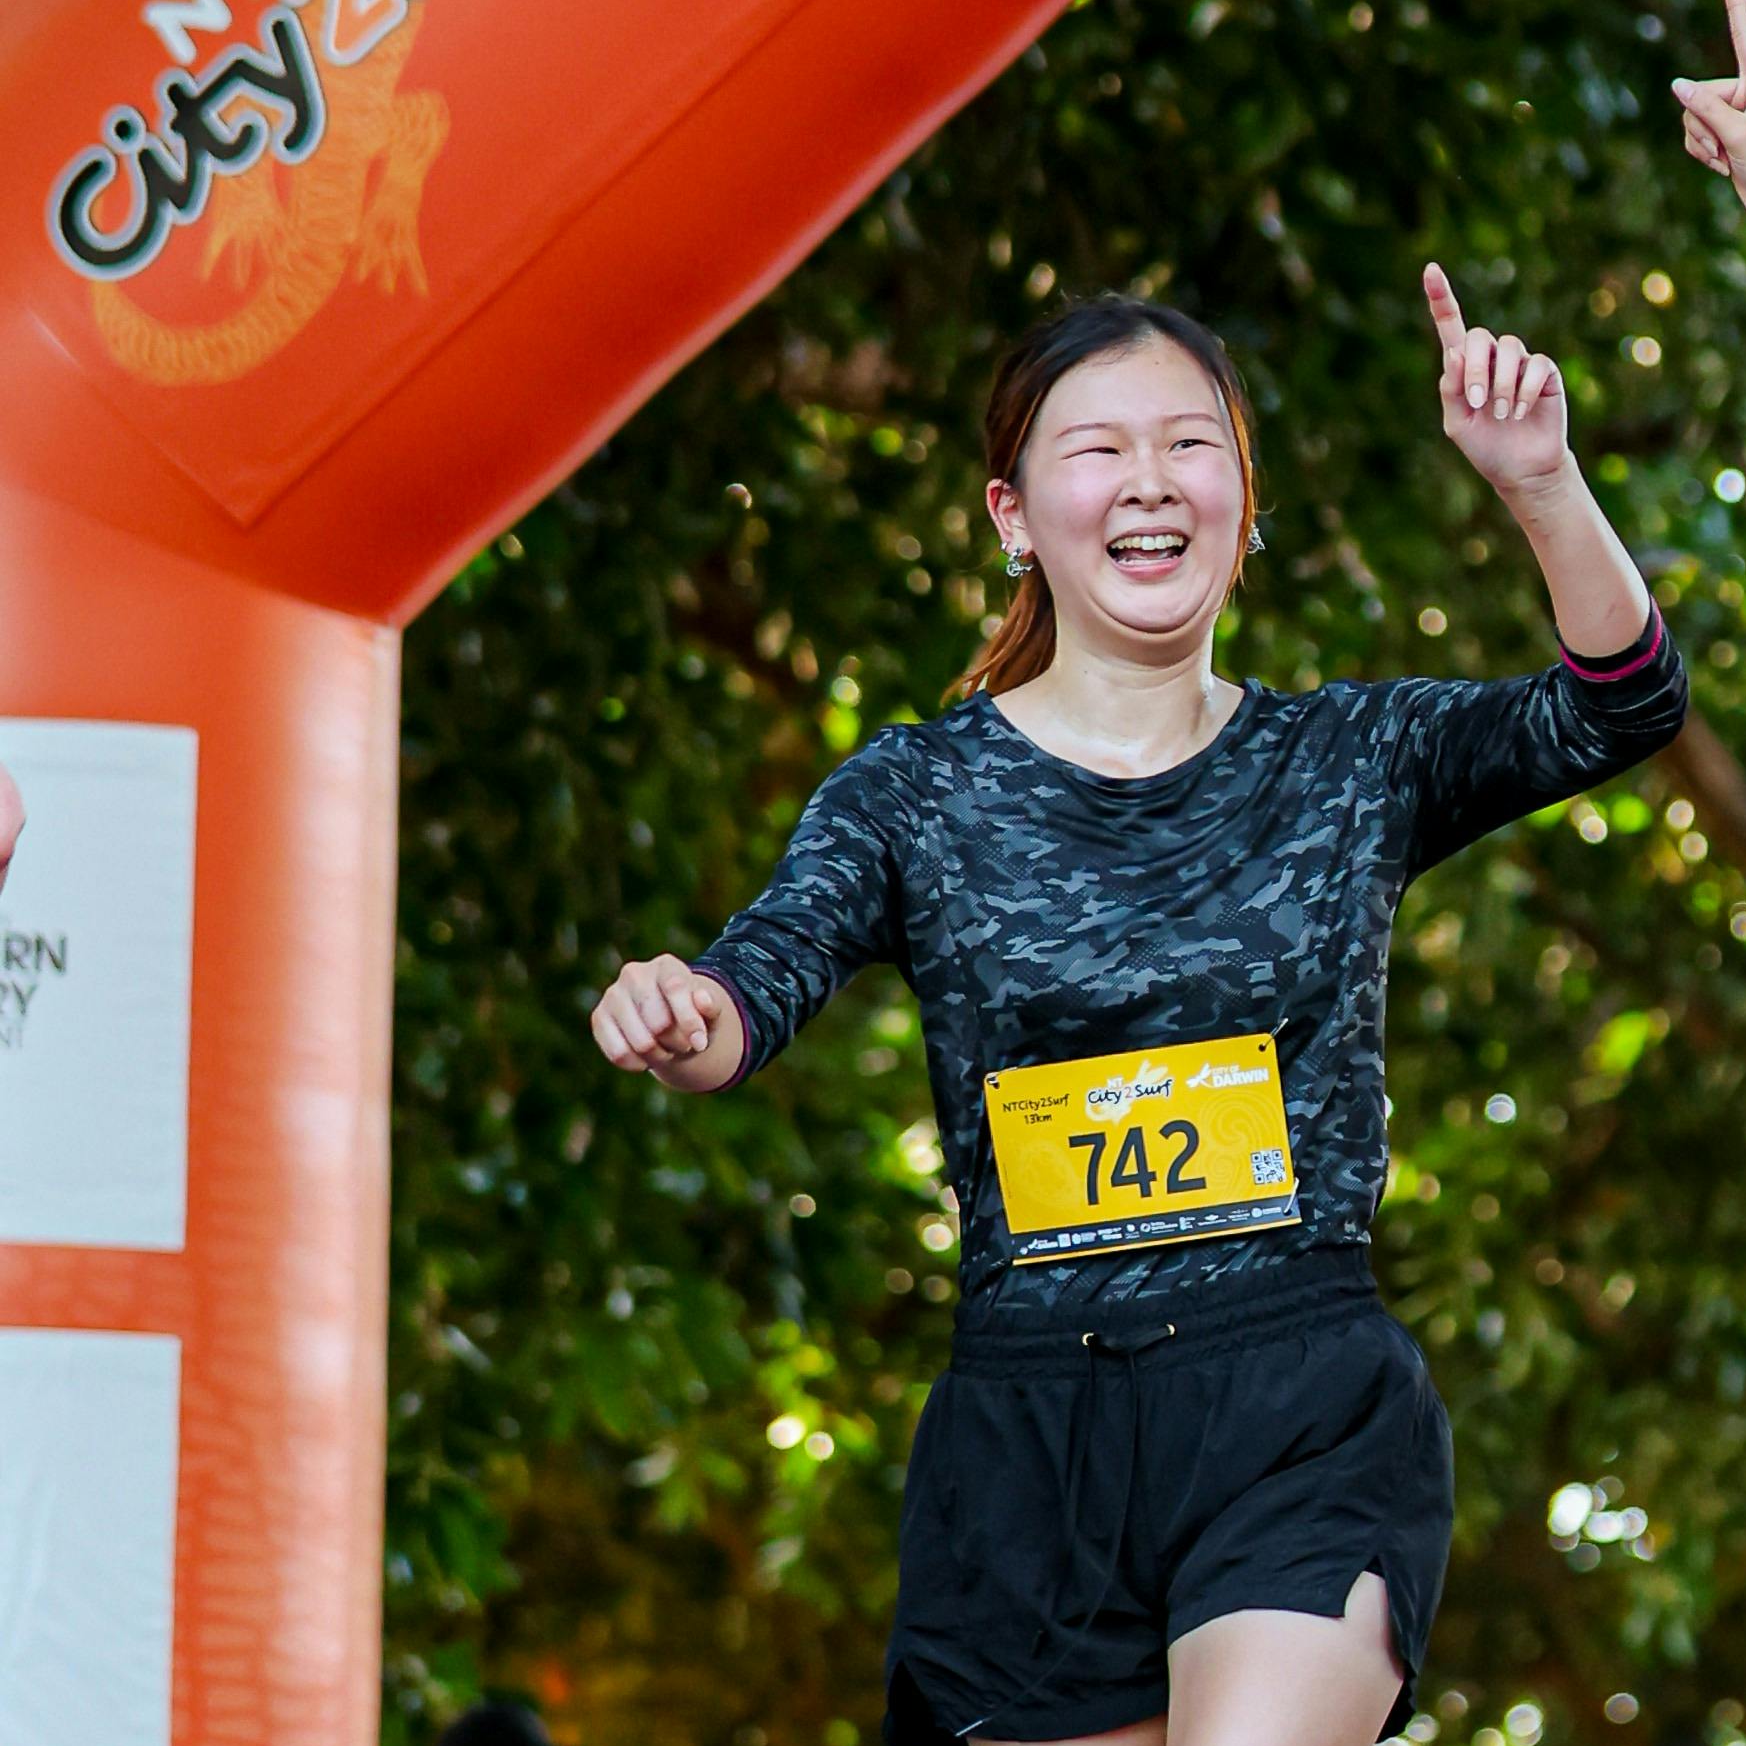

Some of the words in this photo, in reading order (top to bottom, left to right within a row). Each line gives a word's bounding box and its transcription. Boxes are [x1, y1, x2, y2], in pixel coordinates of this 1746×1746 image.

[1107, 1076, 1124, 1089] NT
[1213, 1068, 1269, 1087] DARWIN
[1087, 1078, 1173, 1105] City2Surf
[1002, 1093, 1070, 1113] NTCity2Surf
[1069, 1119, 1207, 1206] 742
